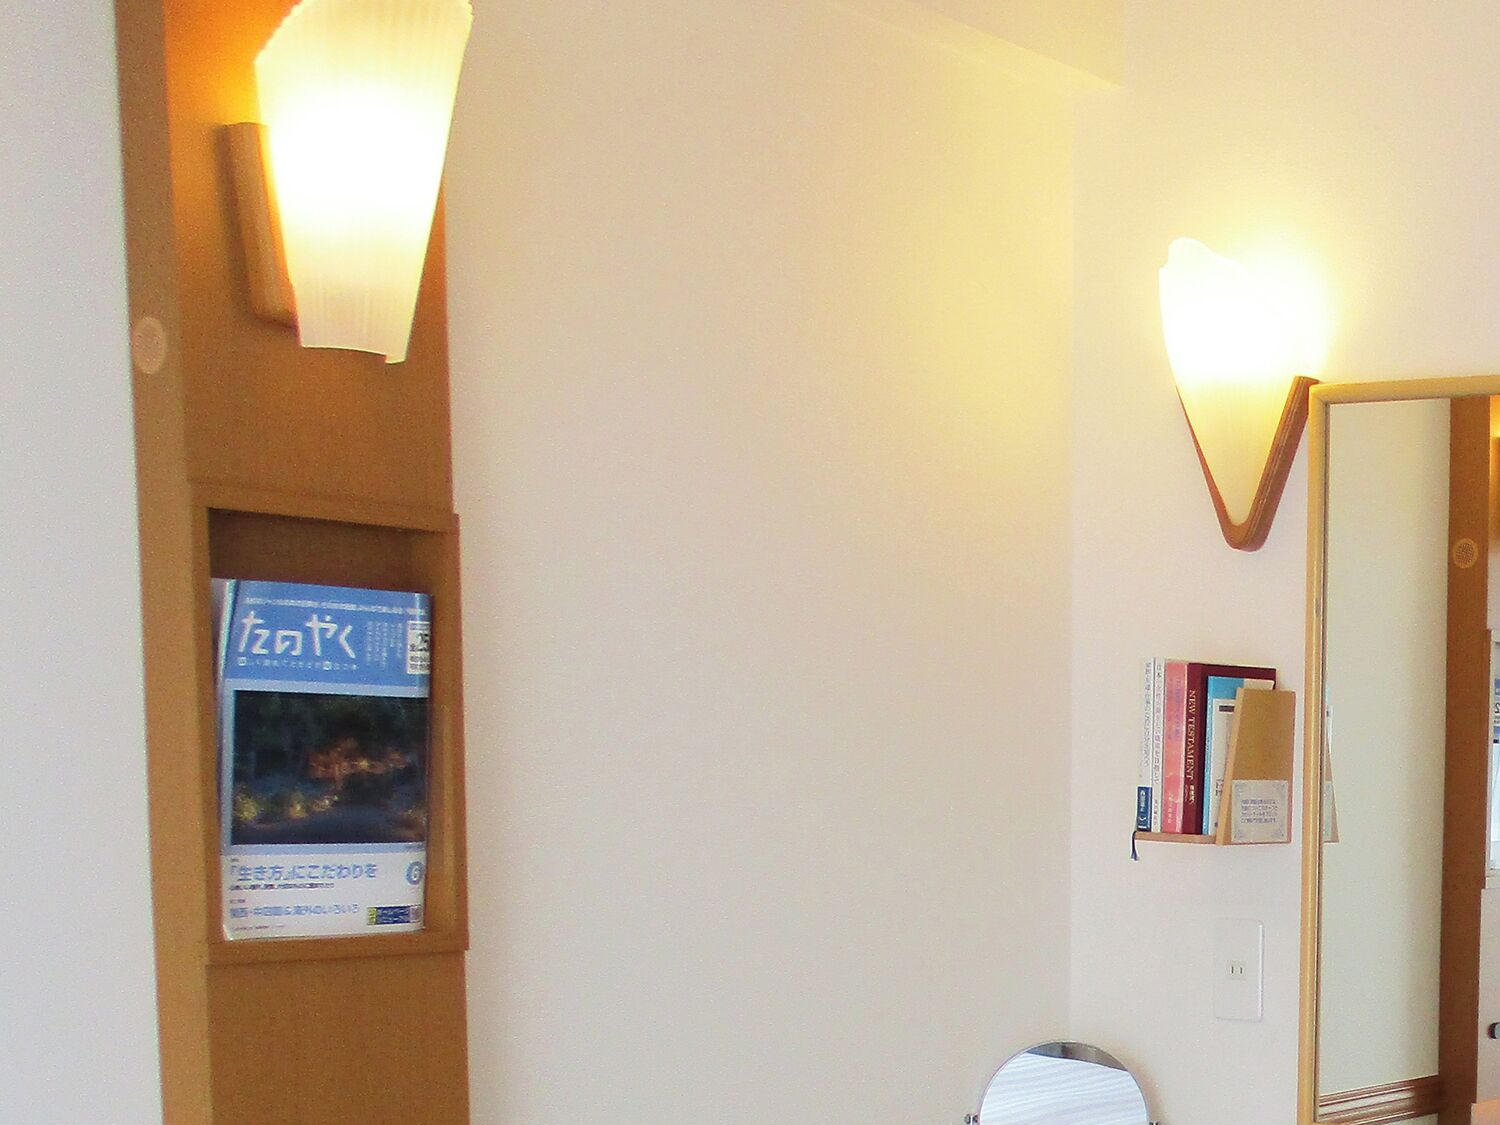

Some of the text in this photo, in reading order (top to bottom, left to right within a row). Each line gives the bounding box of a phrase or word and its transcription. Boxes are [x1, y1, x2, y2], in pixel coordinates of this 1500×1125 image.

[238, 610, 358, 660] たのやく
[1188, 690, 1197, 716] NEW
[1185, 717, 1197, 781] TESTAMENT
